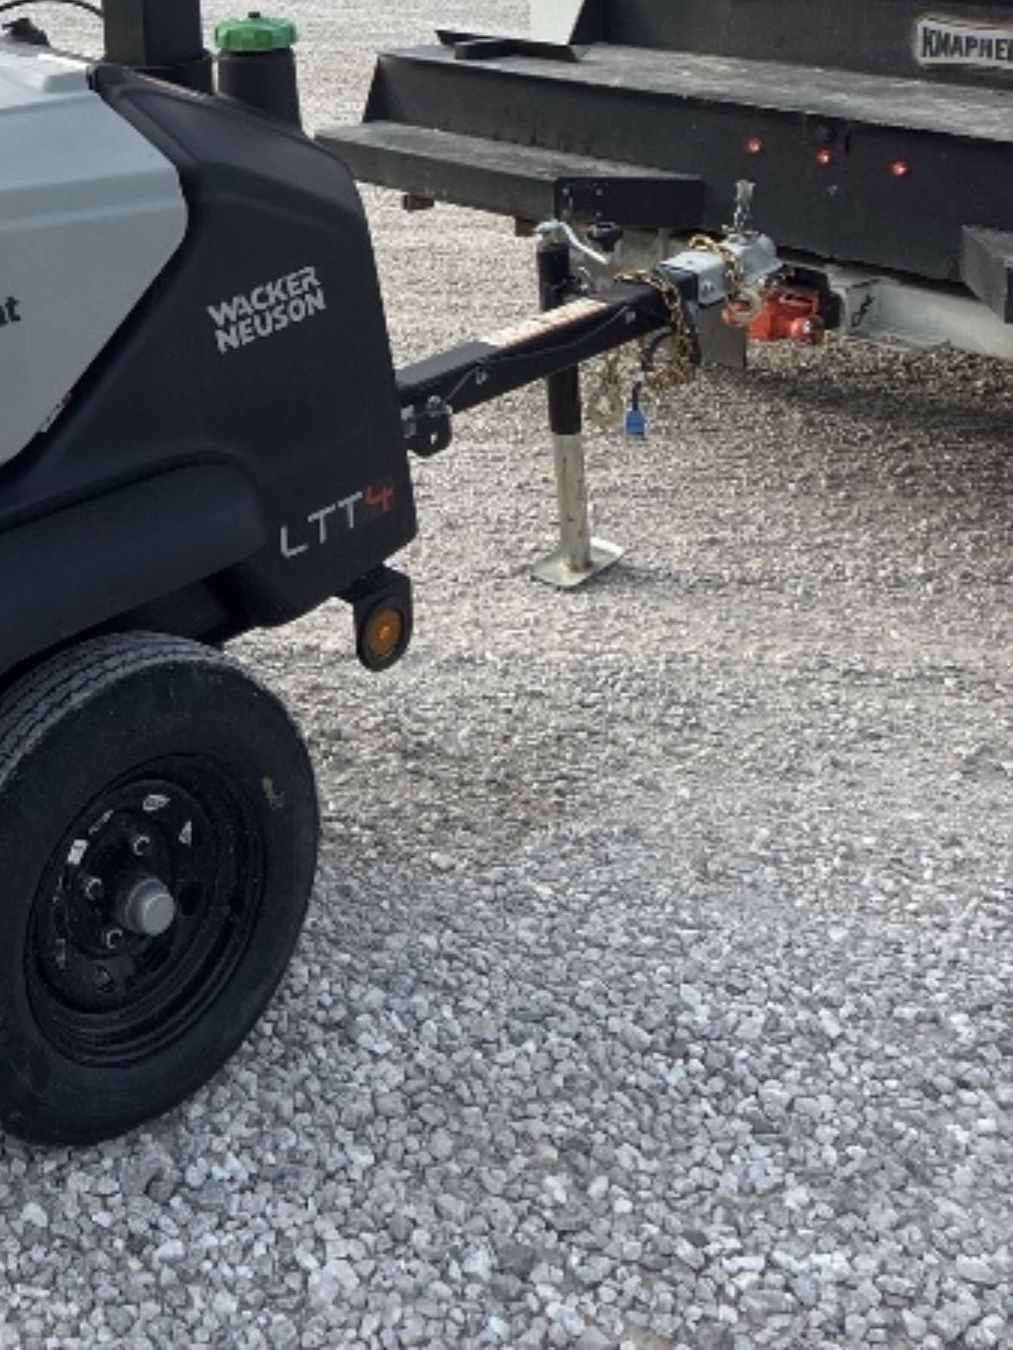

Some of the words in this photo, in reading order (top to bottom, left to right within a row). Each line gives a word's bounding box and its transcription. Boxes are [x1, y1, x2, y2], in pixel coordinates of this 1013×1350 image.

[207, 266, 321, 328] WACKER
[215, 288, 327, 354] NEUSON
[280, 485, 394, 558] LTT4
